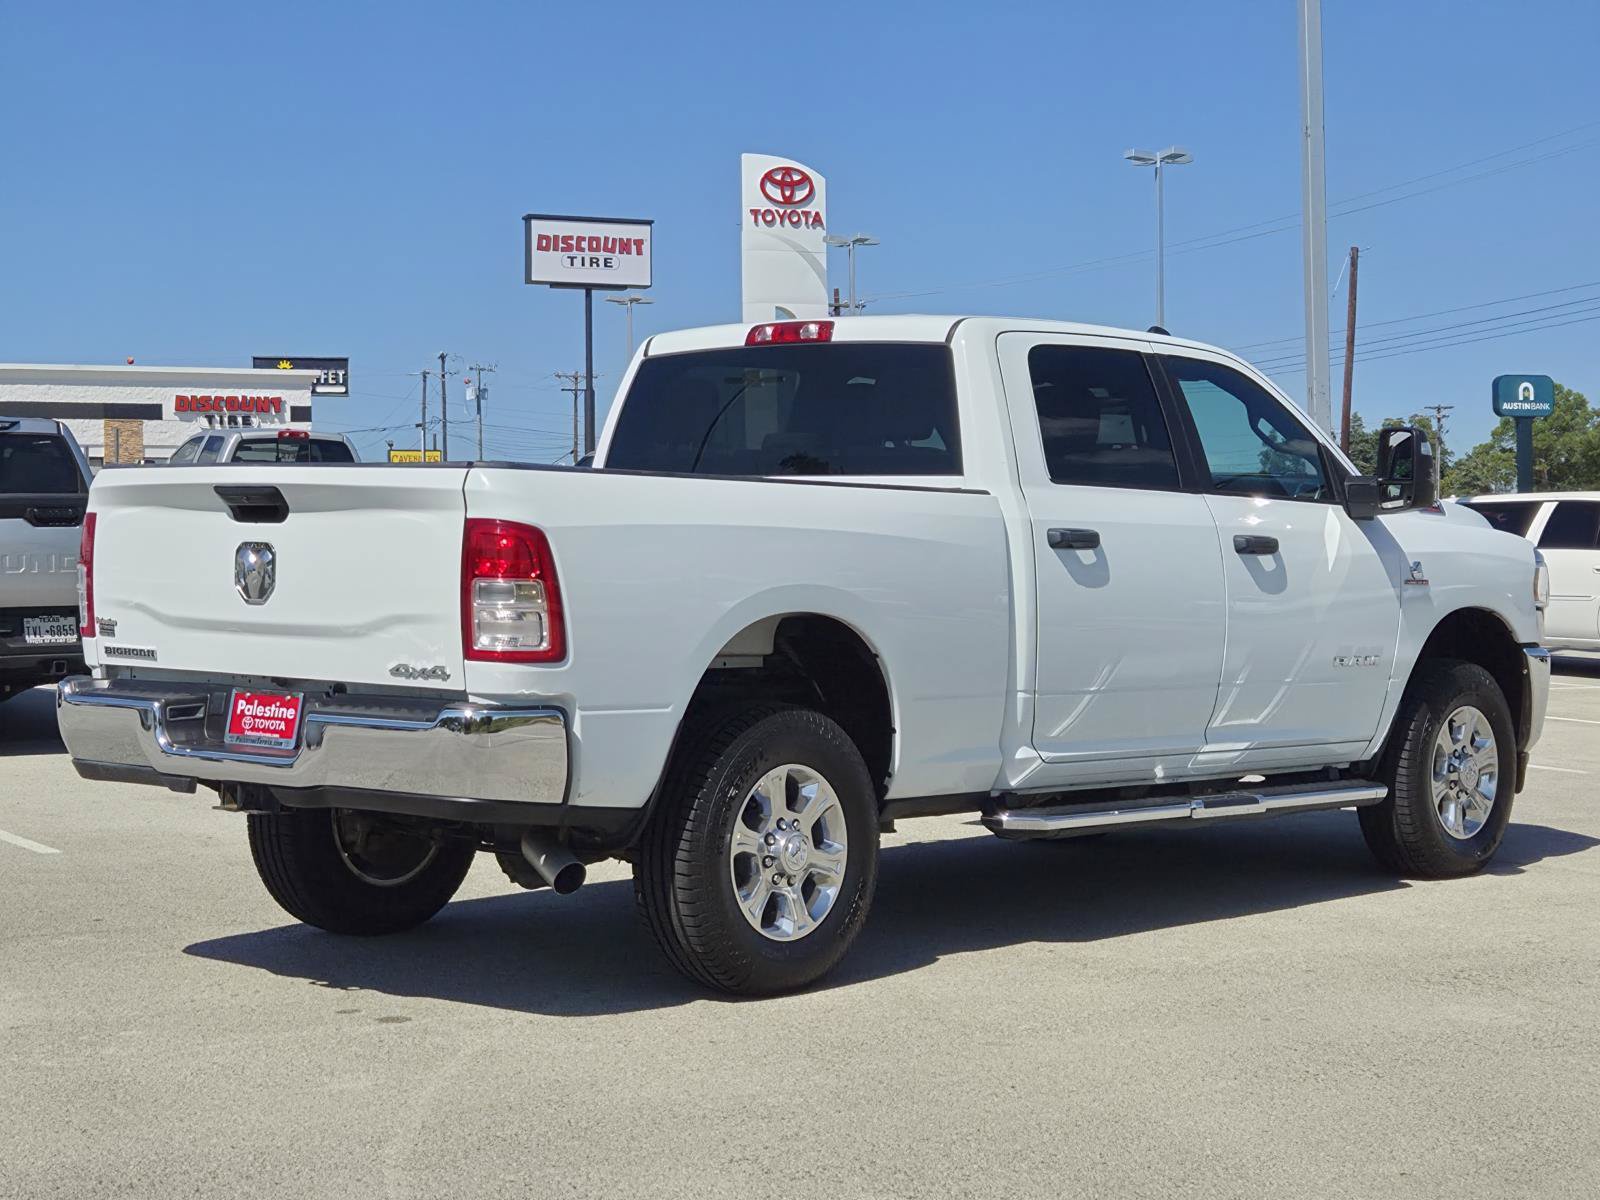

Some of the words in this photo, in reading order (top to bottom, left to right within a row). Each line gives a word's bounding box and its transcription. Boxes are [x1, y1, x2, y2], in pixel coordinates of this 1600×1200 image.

[750, 209, 825, 230] TOYOTA
[537, 234, 645, 256] DISCOUNT
[567, 256, 614, 268] TIRE
[175, 395, 282, 413] DISCOUNT
[205, 415, 251, 426] TIRE
[104, 646, 157, 658] BIGHORN
[237, 699, 295, 719] Palestine
[255, 718, 286, 731] TOYOTA
